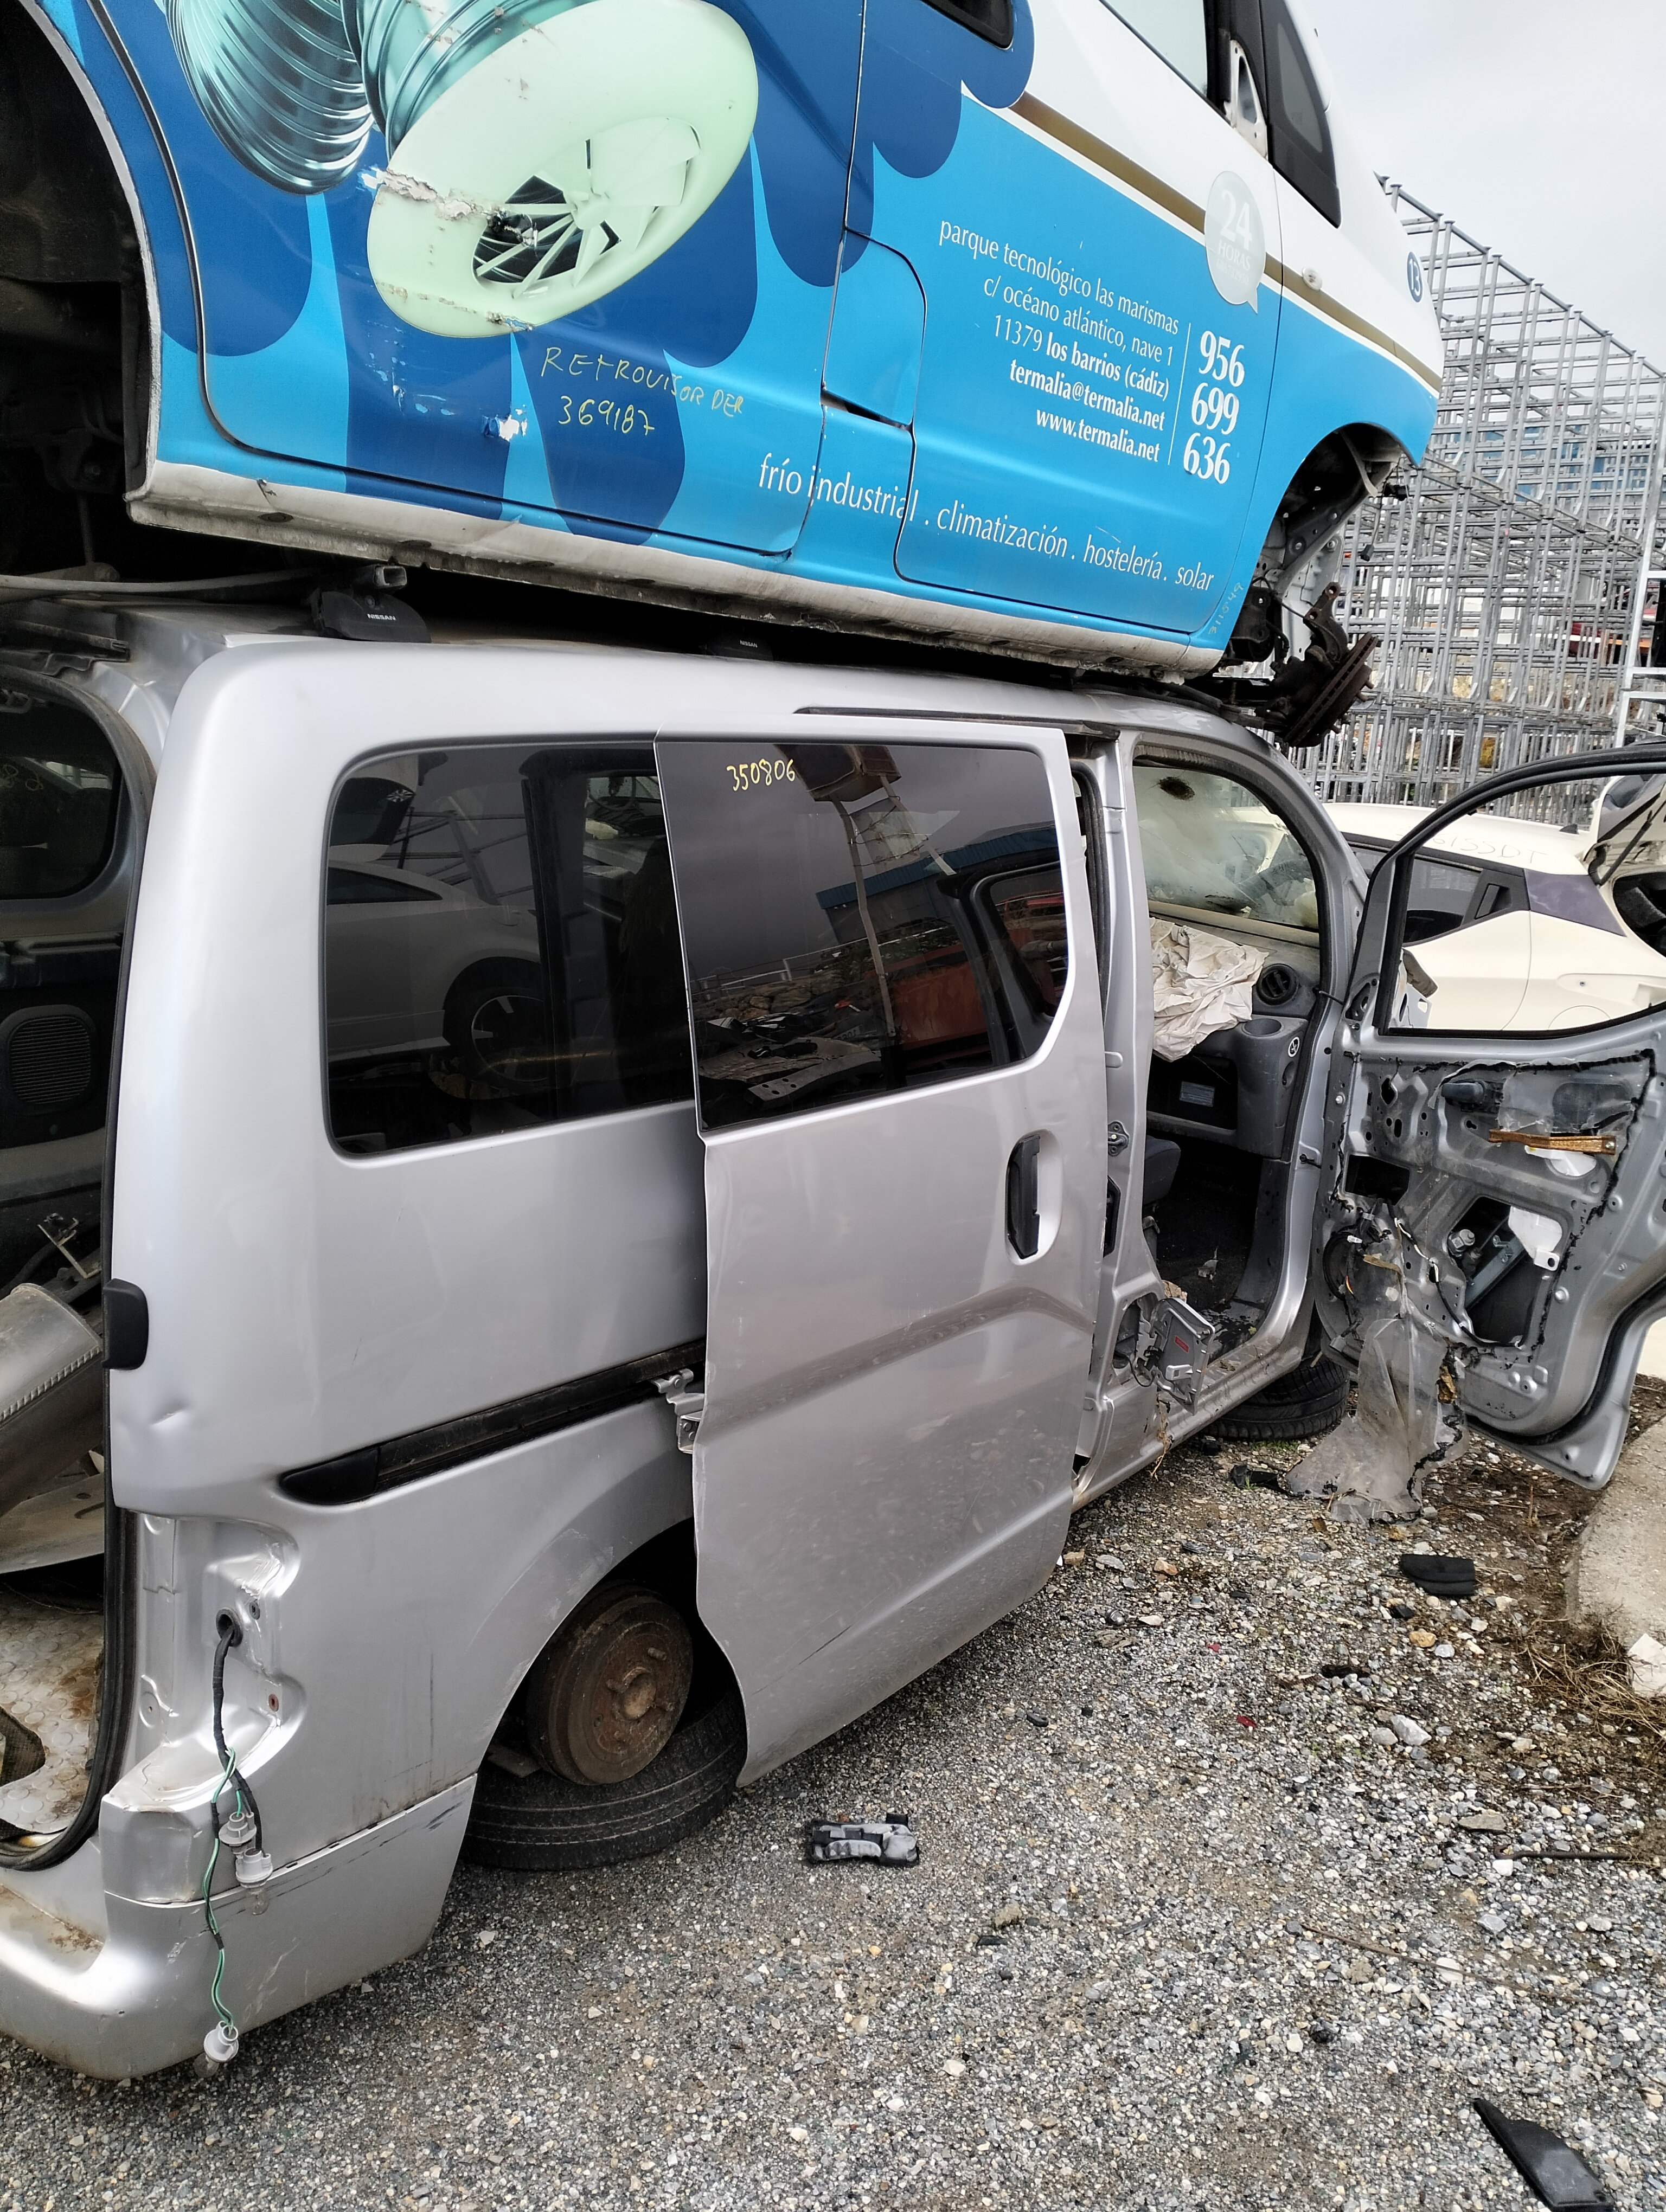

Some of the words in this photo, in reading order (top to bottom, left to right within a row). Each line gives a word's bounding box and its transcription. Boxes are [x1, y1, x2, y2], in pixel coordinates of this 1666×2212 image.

[1220, 190, 1253, 250] 24
[939, 221, 999, 260] parque
[1004, 243, 1091, 297] tecnológico
[1095, 278, 1114, 307] las
[1118, 296, 1179, 335] marismas
[1218, 240, 1251, 271] HORAS
[984, 275, 1001, 297] c/
[1003, 287, 1059, 321] océano
[1062, 306, 1126, 352] atlántico,
[1132, 337, 1162, 362] nave
[1167, 346, 1173, 366] 1
[995, 314, 1042, 351] 11379
[1046, 332, 1067, 361] los
[1071, 341, 1121, 381] barrios
[1125, 364, 1169, 401] (cádiz)
[1199, 330, 1245, 387] 956
[558, 396, 655, 435] 369187
[711, 389, 742, 417] DER
[1010, 359, 1165, 431] termalia@termalia.net
[1191, 382, 1239, 435] 699
[1036, 409, 1160, 462] www.termalia.net
[1183, 432, 1231, 484] 636
[759, 453, 802, 494] frío
[808, 465, 919, 522] industrial
[937, 500, 1068, 558] climatización
[1175, 562, 1214, 591] solar
[367, 613, 396, 621] NISSAN
[740, 640, 758, 648] NISSAN
[726, 758, 796, 792] 350806
